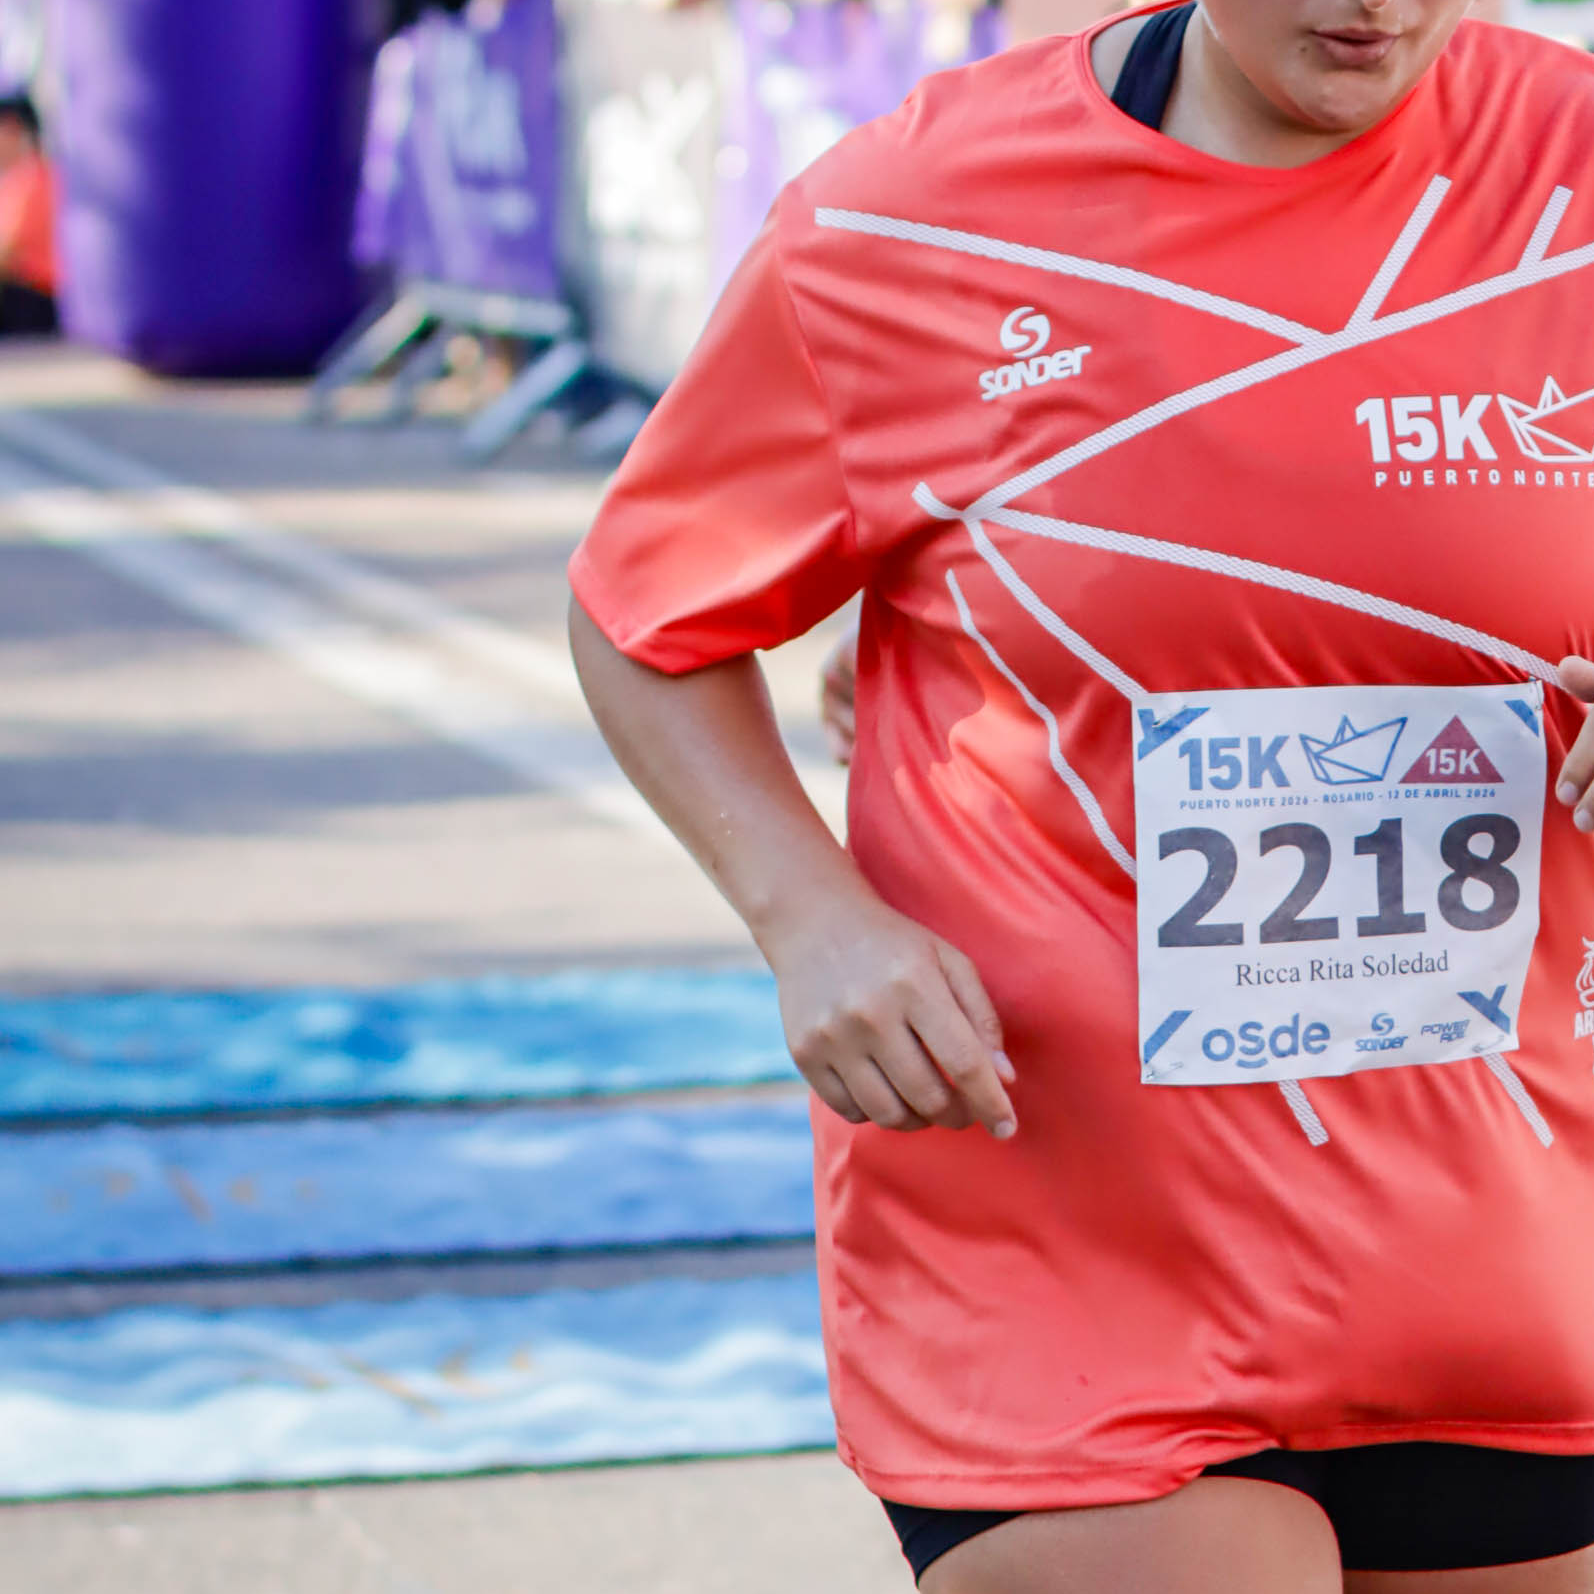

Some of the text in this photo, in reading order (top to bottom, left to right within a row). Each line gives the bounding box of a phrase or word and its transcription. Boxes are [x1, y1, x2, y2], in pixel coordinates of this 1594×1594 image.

[1355, 394, 1498, 463] 15K
[1375, 468, 1501, 487] PUERTO
[1179, 735, 1291, 791] 15K
[1425, 748, 1480, 777] 15K
[1179, 798, 1231, 810] PUERTO
[1236, 796, 1275, 808] NORTE
[1323, 791, 1374, 803] ROSARIO
[1405, 788, 1419, 798] DE
[1424, 788, 1461, 798] ABRIL
[1157, 813, 1521, 948] 2218
[1236, 950, 1449, 986] Ricca Rita Soledad
[1201, 1013, 1331, 1058] osde
